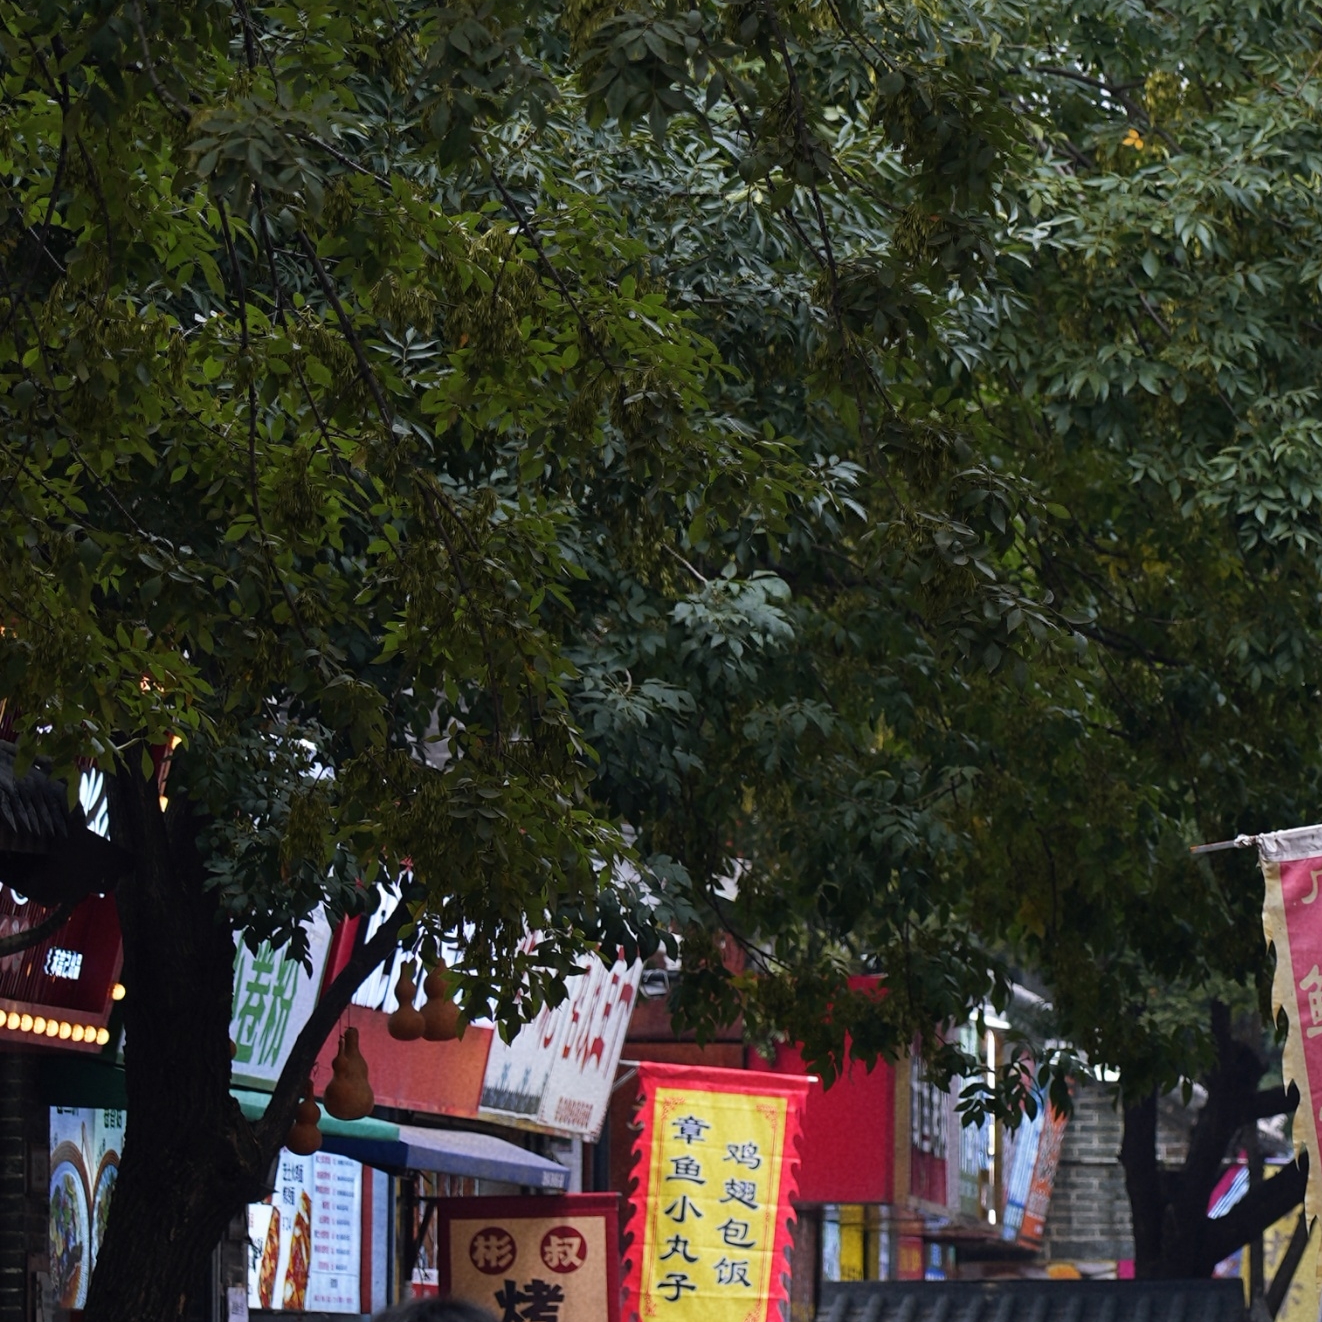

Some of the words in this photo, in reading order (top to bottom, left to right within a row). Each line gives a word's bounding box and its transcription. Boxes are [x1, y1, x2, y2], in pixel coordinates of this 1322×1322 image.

[472, 1233, 583, 1269] 彬叔
[656, 1115, 711, 1303] 章鱼小丸子
[713, 1141, 762, 1288] 鸡翅包饭
